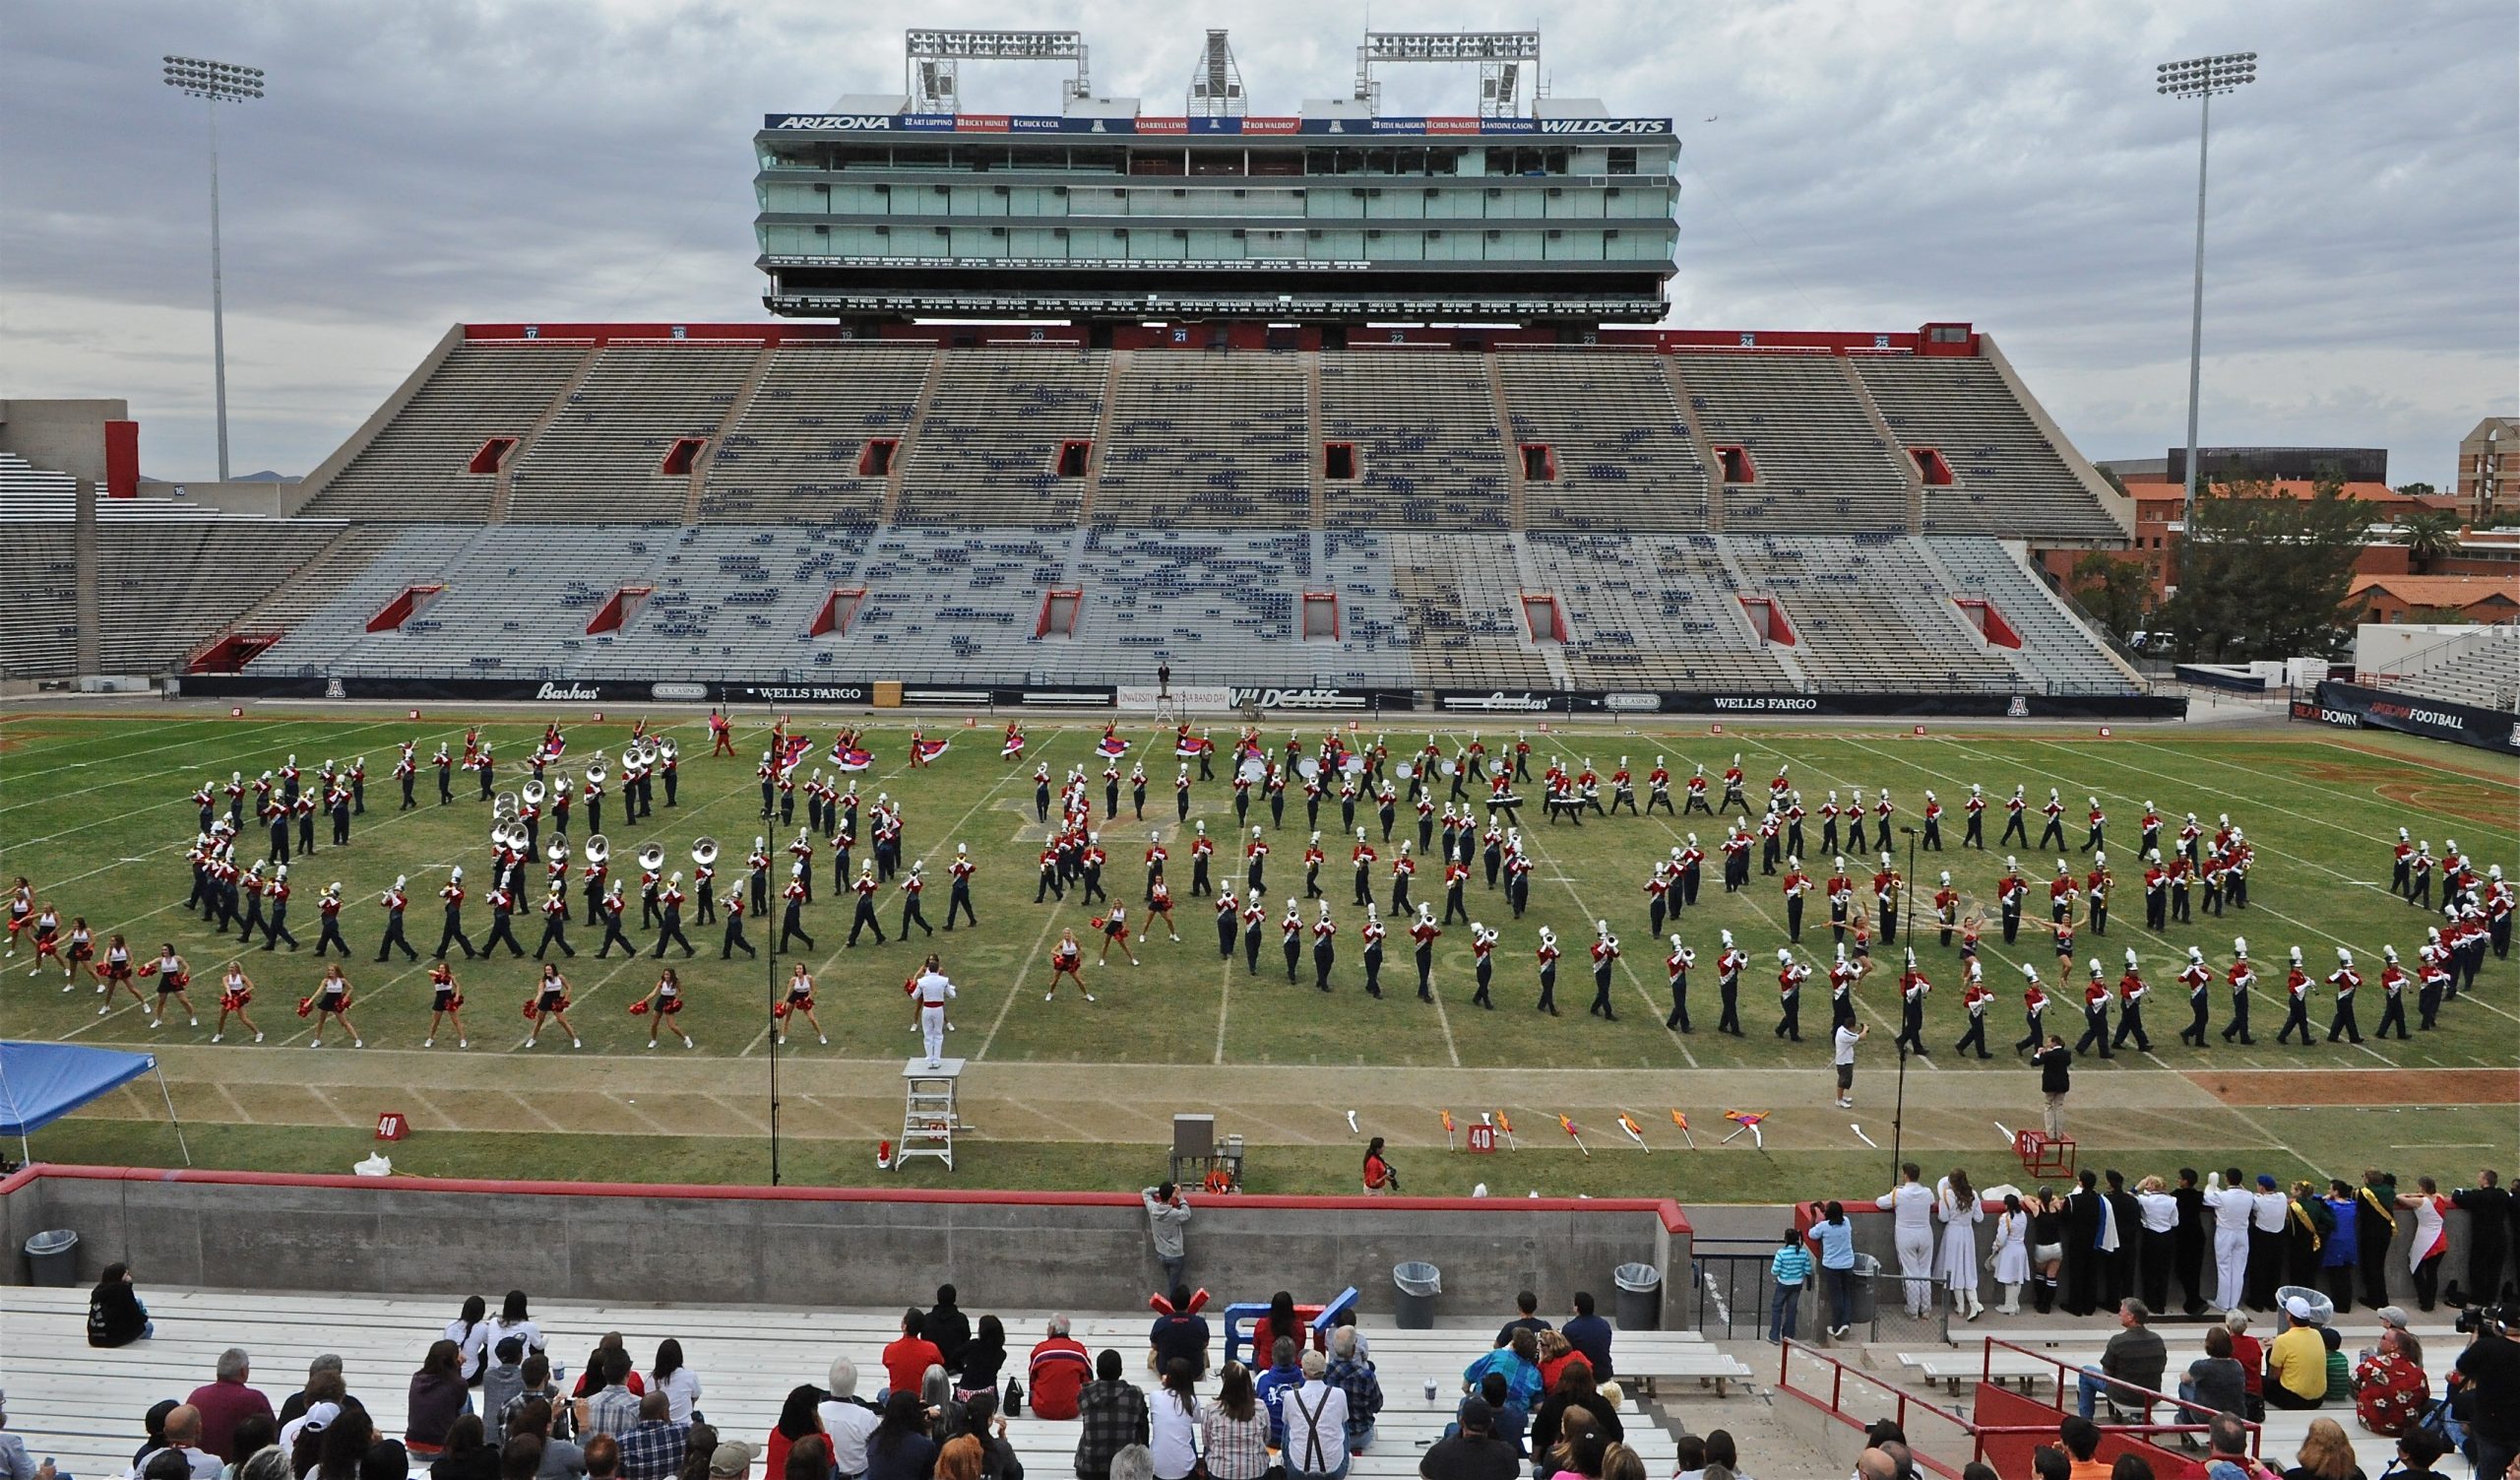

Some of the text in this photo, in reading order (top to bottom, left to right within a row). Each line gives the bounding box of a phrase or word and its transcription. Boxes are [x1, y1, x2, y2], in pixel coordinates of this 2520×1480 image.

[778, 116, 890, 129] ARIZONA
[1541, 120, 1665, 134] WILDCATS
[843, 331, 851, 340] 19
[1741, 338, 1754, 347] 24
[1876, 340, 1888, 349] 25
[536, 681, 599, 700] Bashas'
[759, 688, 860, 699] WELLS FARGO
[1120, 693, 1154, 702] UNIVERSITY
[1194, 693, 1213, 703] BAND
[1213, 693, 1227, 703] DAY
[1714, 698, 1817, 709] WELLS FARGO
[378, 1117, 398, 1136] 40
[1473, 1128, 1490, 1148] 40
